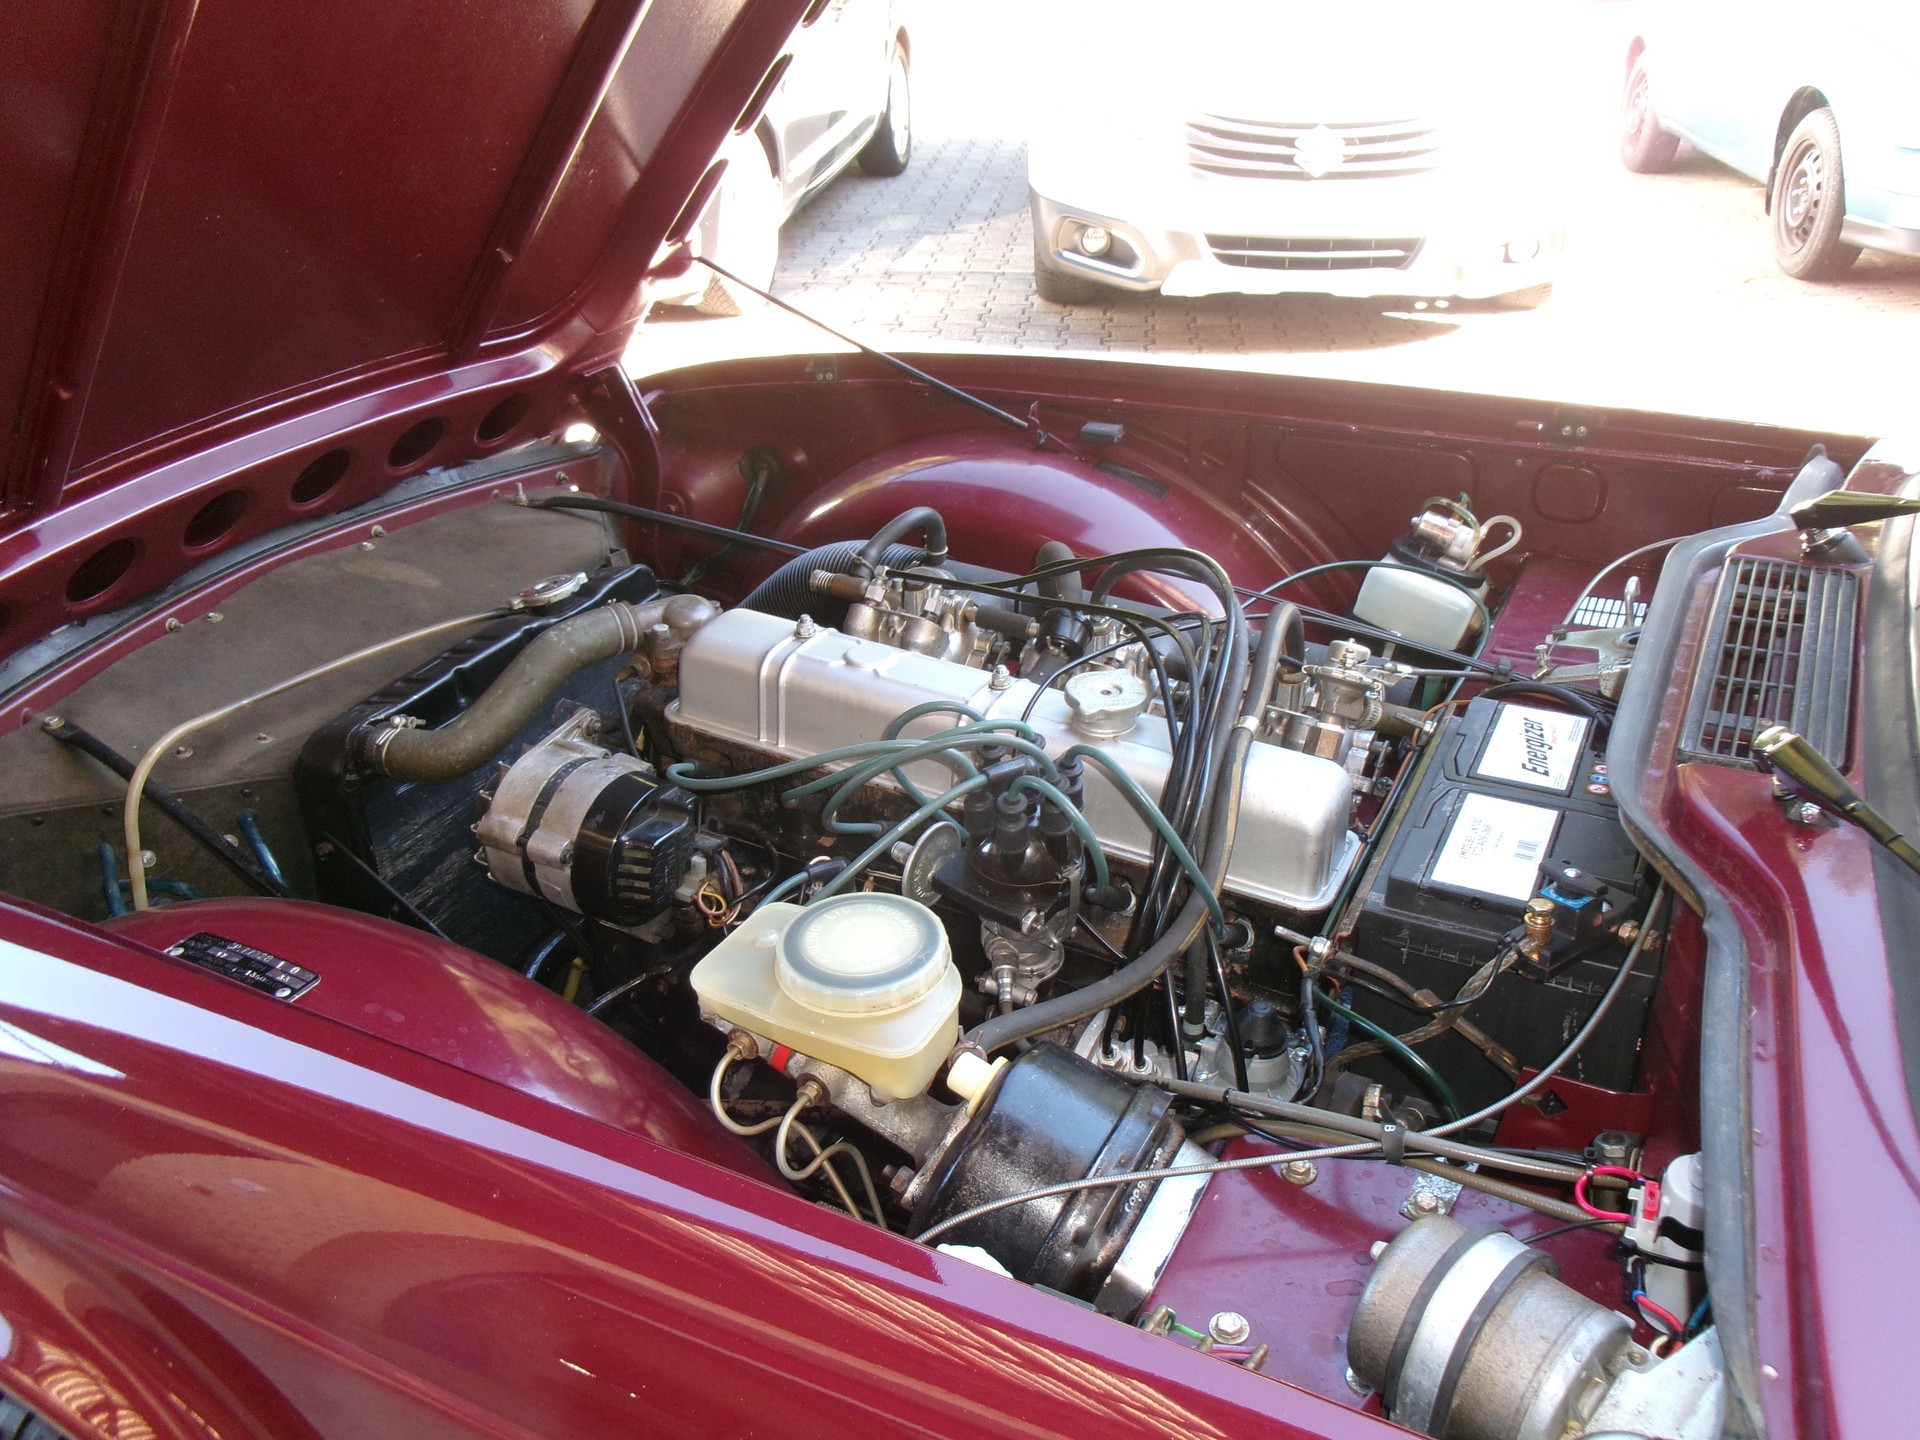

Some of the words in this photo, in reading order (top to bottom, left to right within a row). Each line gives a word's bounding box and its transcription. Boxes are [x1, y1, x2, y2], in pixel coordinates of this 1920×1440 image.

[1520, 717, 1553, 777] Energizer
[805, 924, 832, 963] GIRLING
[866, 903, 917, 938] ENGLAND
